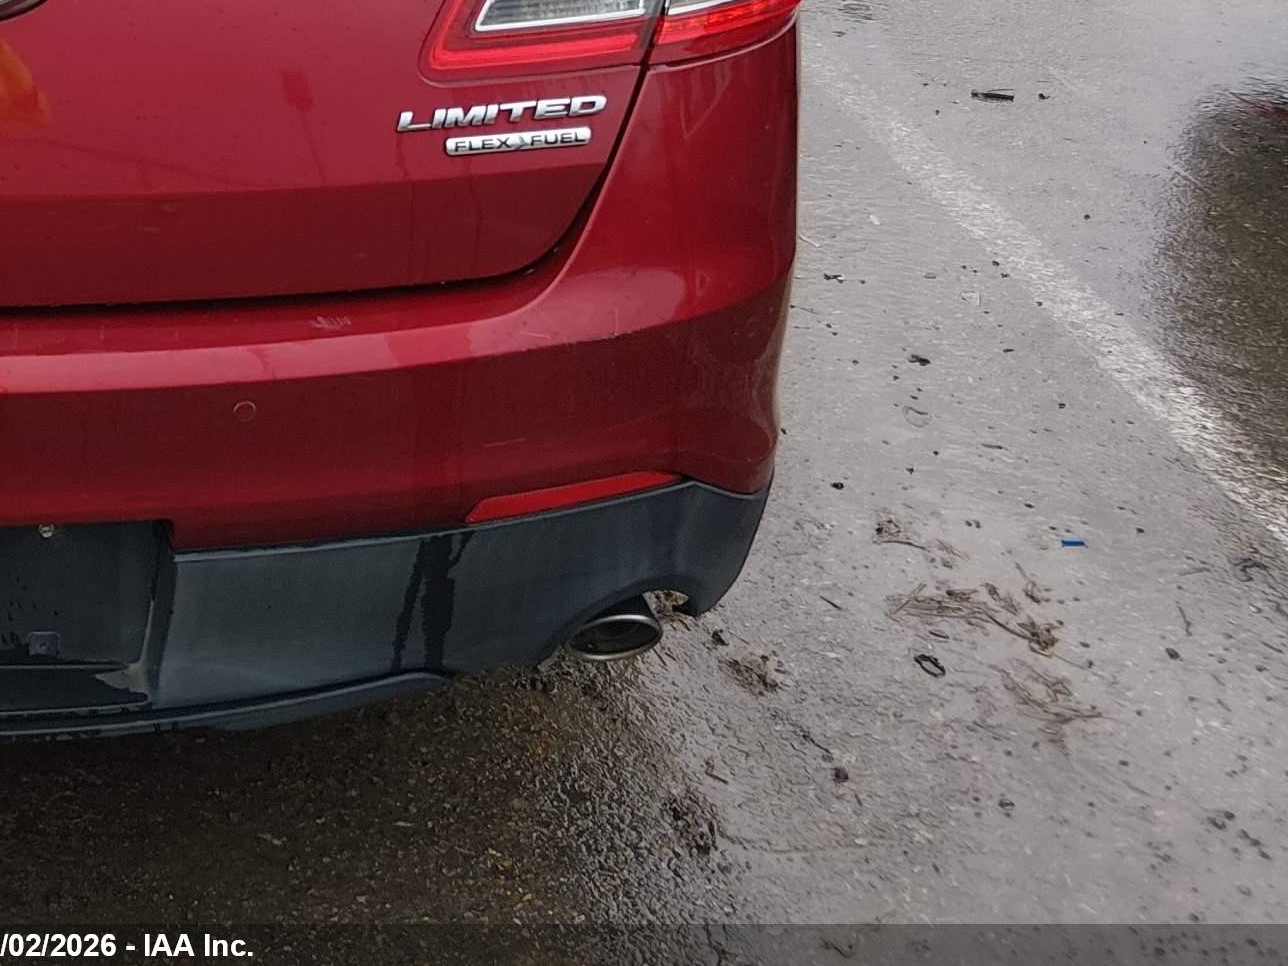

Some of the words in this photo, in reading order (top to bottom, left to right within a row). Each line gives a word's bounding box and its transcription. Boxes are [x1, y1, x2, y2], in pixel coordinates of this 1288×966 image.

[396, 95, 607, 132] LIMITED
[454, 137, 511, 152] FLEX
[530, 132, 586, 147] FUEL
